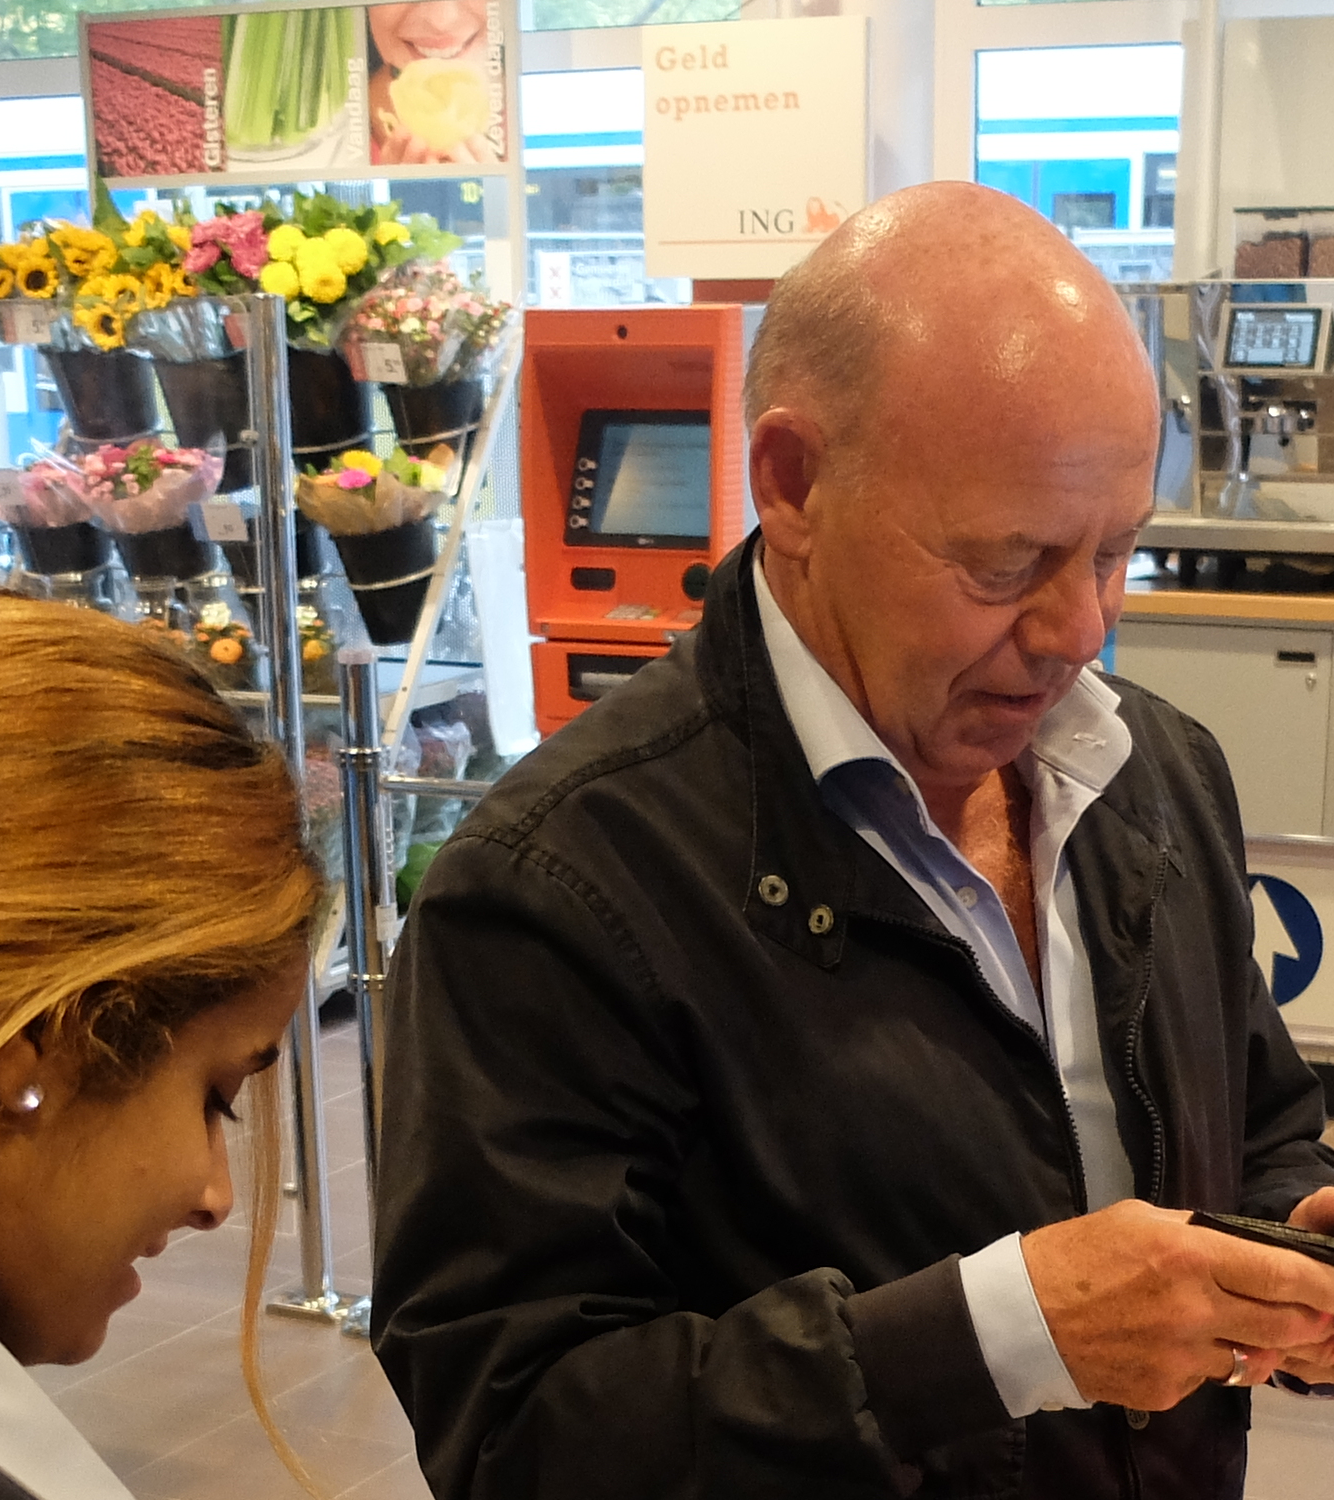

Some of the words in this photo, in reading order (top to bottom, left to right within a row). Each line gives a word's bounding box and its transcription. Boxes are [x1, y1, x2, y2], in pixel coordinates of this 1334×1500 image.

[486, 0, 505, 83] dagen
[655, 44, 729, 71] Geld
[202, 68, 217, 166] Gisteren
[346, 58, 364, 160] Vandaag
[486, 86, 505, 156] Zeven
[655, 91, 800, 121] opnemen
[739, 209, 794, 234] ING
